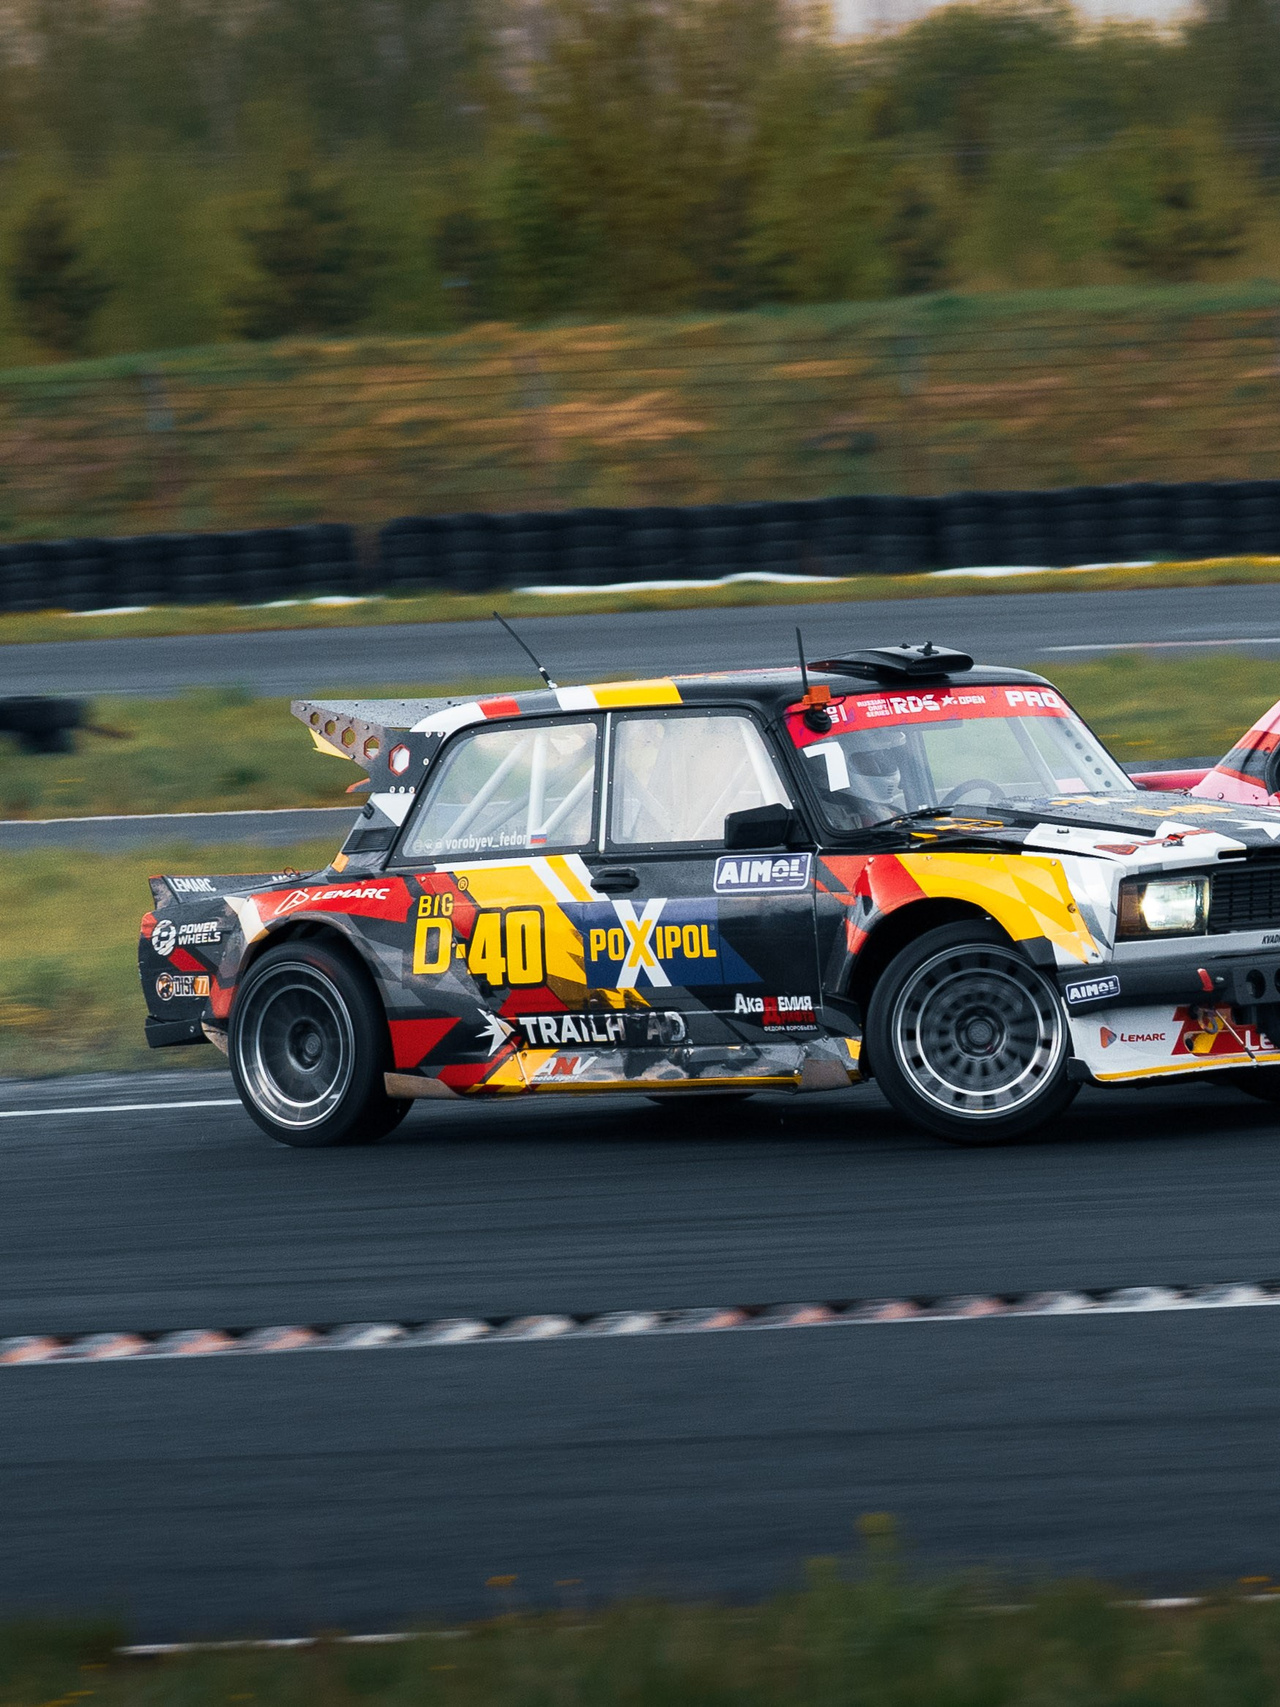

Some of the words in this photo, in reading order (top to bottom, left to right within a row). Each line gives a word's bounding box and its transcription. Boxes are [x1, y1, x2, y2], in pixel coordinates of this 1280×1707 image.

[889, 694, 941, 714] RDS
[957, 695, 986, 705] OPEN
[1004, 690, 1061, 709] PRO
[445, 831, 527, 852] vorobyev_fedor
[717, 859, 804, 885] AIMOL
[169, 878, 216, 893] LEMARC
[311, 888, 390, 901] LEMARC
[418, 893, 453, 917] BIG
[179, 921, 218, 934] POWER
[178, 931, 221, 946] WHEELS
[412, 909, 544, 987] D-40
[589, 908, 717, 978] POXIPOL
[1069, 981, 1118, 1001] AIMOL
[518, 1011, 687, 1045] TRAILHAD
[1120, 1032, 1166, 1043] LEMARC
[533, 1056, 599, 1076] ANV
